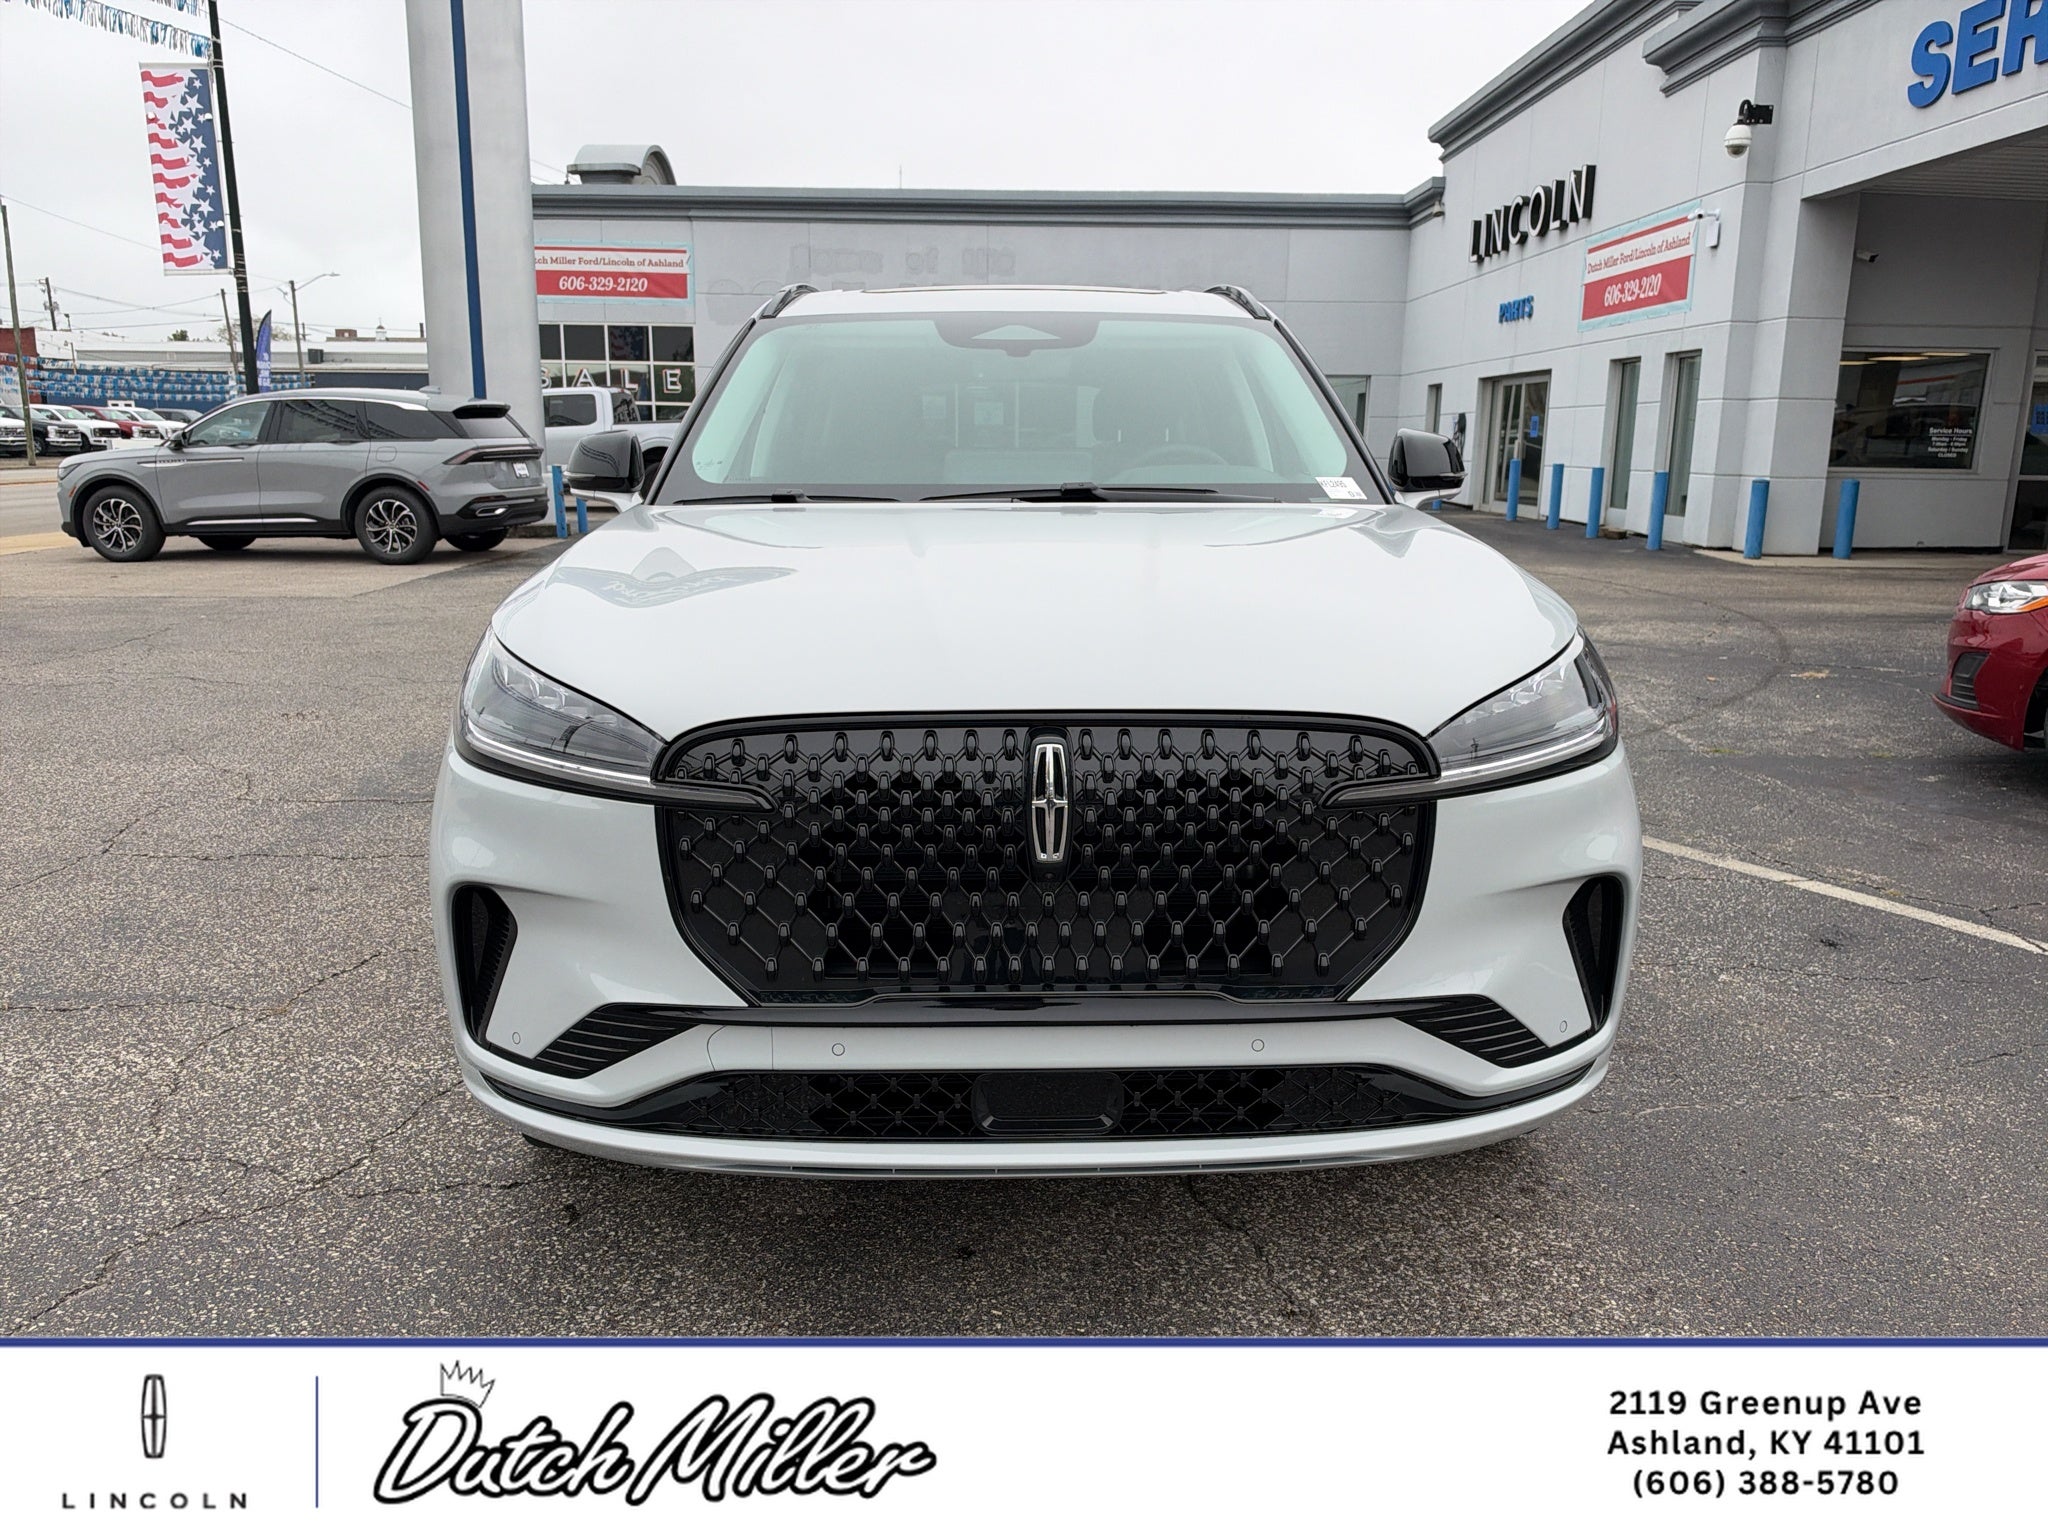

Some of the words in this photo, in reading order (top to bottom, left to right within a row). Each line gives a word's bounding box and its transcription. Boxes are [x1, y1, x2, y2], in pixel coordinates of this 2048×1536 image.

[1907, 0, 2048, 108] SER
[1470, 164, 1597, 262] LINCOLN
[1657, 240, 1665, 255] of
[1664, 232, 1691, 252] Ashland
[550, 257, 576, 265] Miller
[578, 257, 635, 267] Ford/Lincoln
[637, 258, 646, 267] of
[648, 259, 684, 268] Ashland
[559, 275, 648, 292] 606-329-2120
[1604, 272, 1662, 307] 606-329-2120
[1498, 295, 1535, 324] PARTS
[540, 366, 682, 394] SALE
